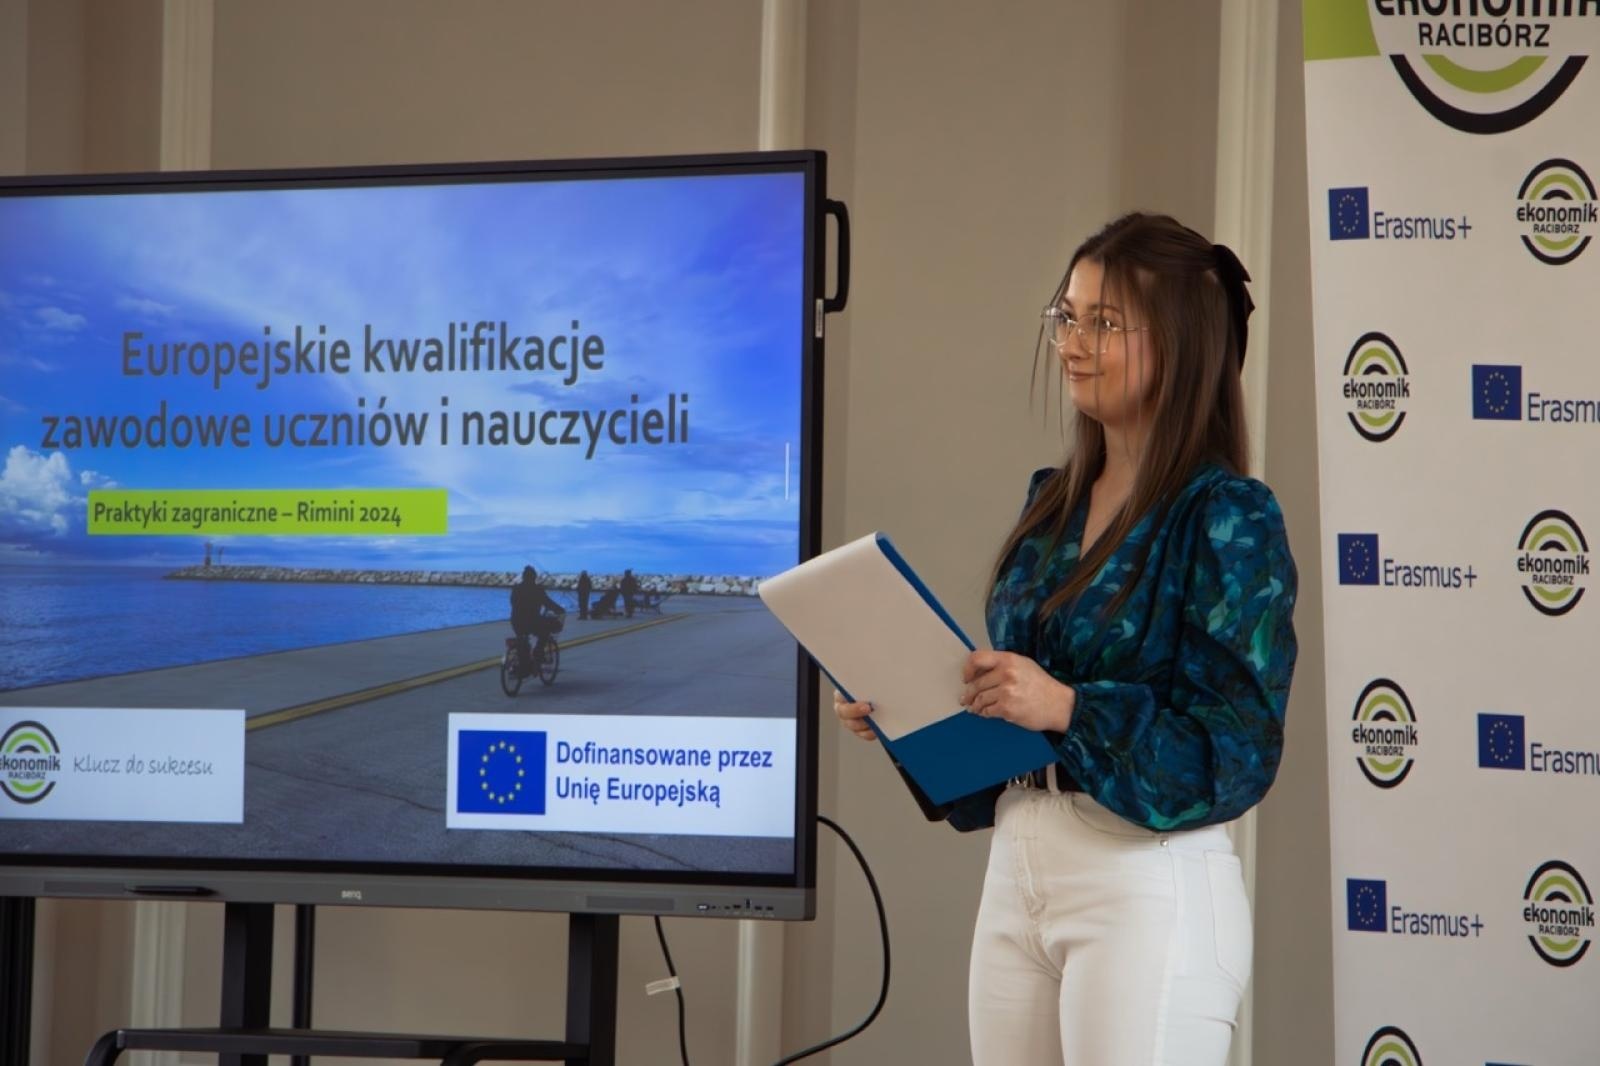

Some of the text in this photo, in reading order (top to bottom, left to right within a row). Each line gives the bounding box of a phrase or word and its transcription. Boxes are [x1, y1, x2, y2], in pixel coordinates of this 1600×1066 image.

[1418, 18, 1550, 47] RACIBÓRZ
[1374, 212, 1472, 239] Erasmus+
[1516, 202, 1598, 222] ekonomik
[1533, 222, 1580, 233] RACIBÓRZ
[121, 320, 605, 390] Europejskie kwalifikacje
[1343, 378, 1410, 399] ekonomik
[1528, 392, 1600, 423] Erasm
[41, 394, 690, 460] zawodowe uczniów i nauczycieli
[94, 500, 168, 528] Praktyki
[172, 500, 278, 529] zagraniczne
[297, 500, 355, 523] Rimini
[359, 506, 402, 528] 2024
[1383, 559, 1477, 589] Erasmus+
[1517, 553, 1590, 575] ekonomik
[1532, 574, 1574, 585] RACIBÓRZ
[1352, 724, 1418, 746] ekonomik
[0, 753, 214, 775] konomik Klucz do sukcesu
[556, 741, 773, 772] Dofinansowane przez
[1530, 742, 1600, 776] Erasm
[556, 776, 721, 808] Unię Europejską
[1391, 906, 1484, 937] Erasmus+
[1523, 902, 1595, 927] ekonomik
